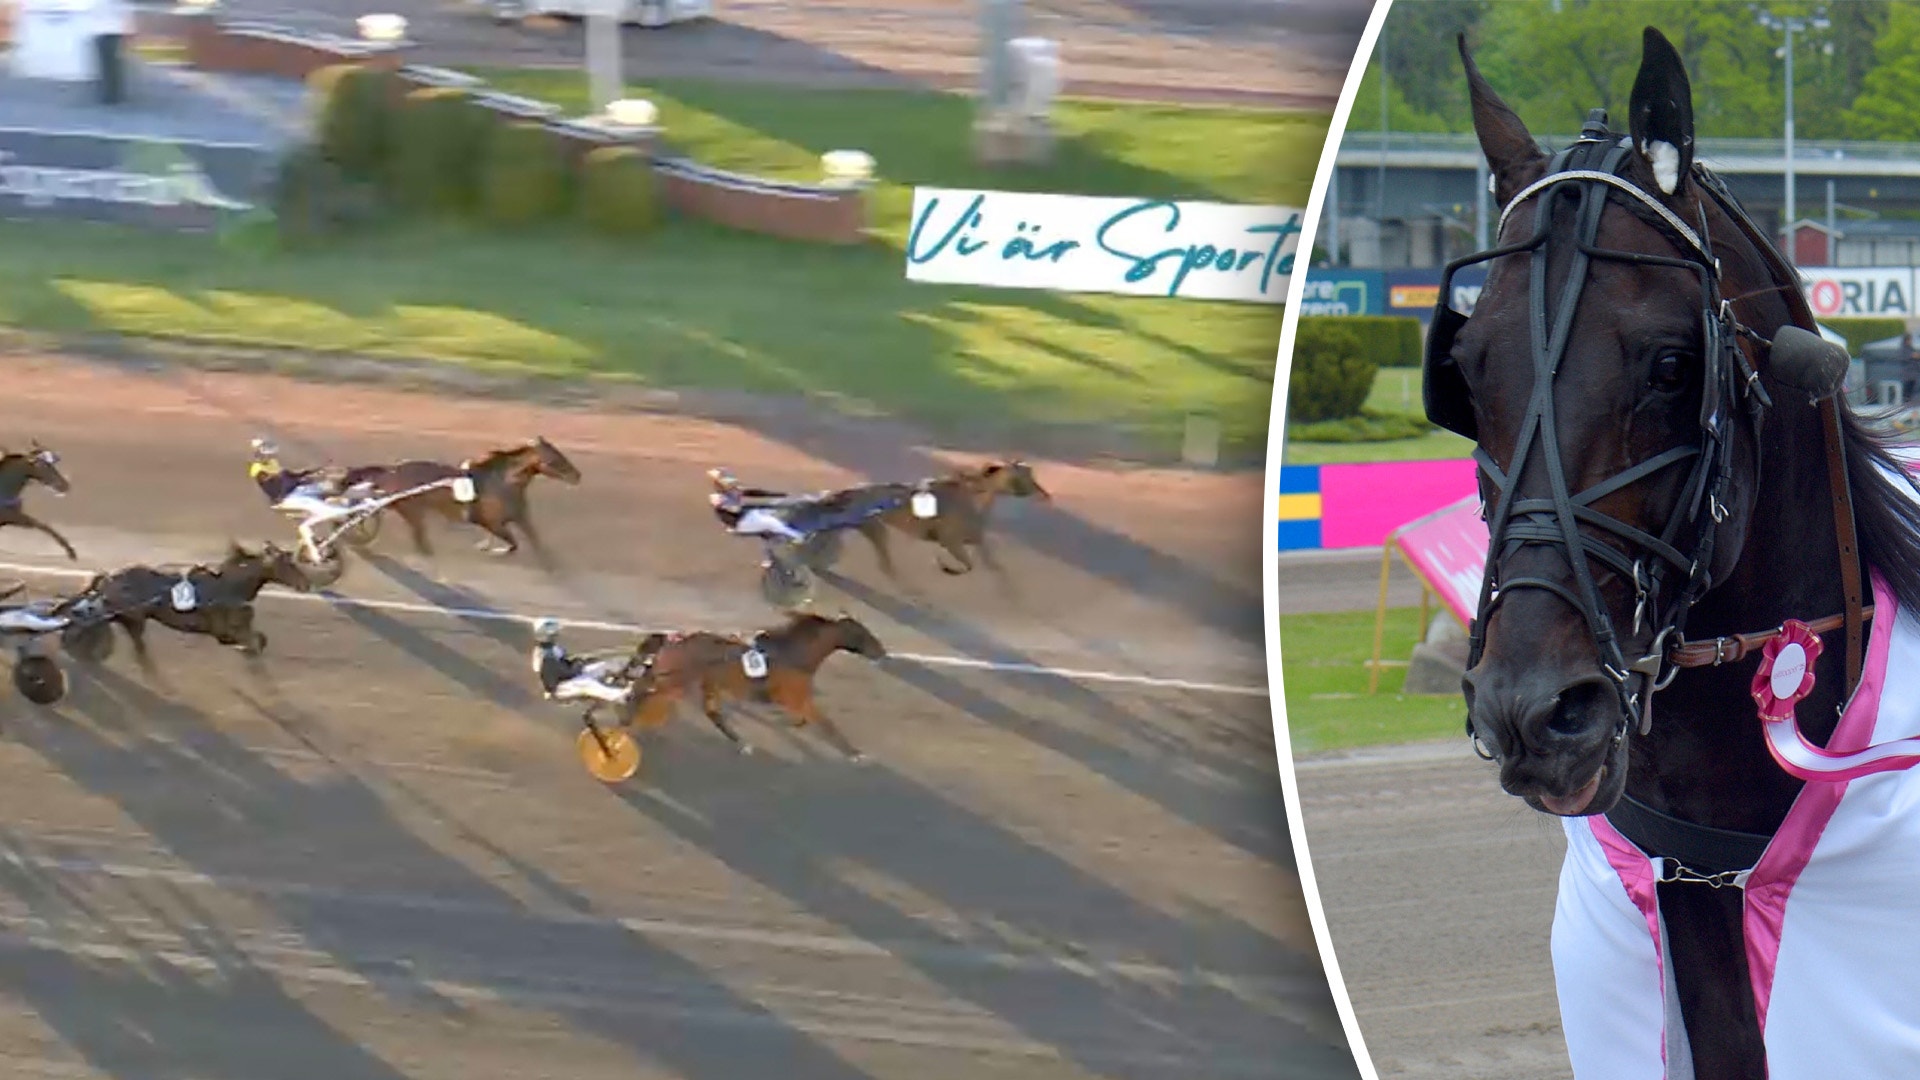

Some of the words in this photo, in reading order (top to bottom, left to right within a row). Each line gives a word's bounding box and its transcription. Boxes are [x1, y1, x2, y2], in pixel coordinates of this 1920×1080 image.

[908, 194, 987, 263] Vi
[1002, 222, 1081, 263] är
[1801, 279, 1907, 315] ORIA
